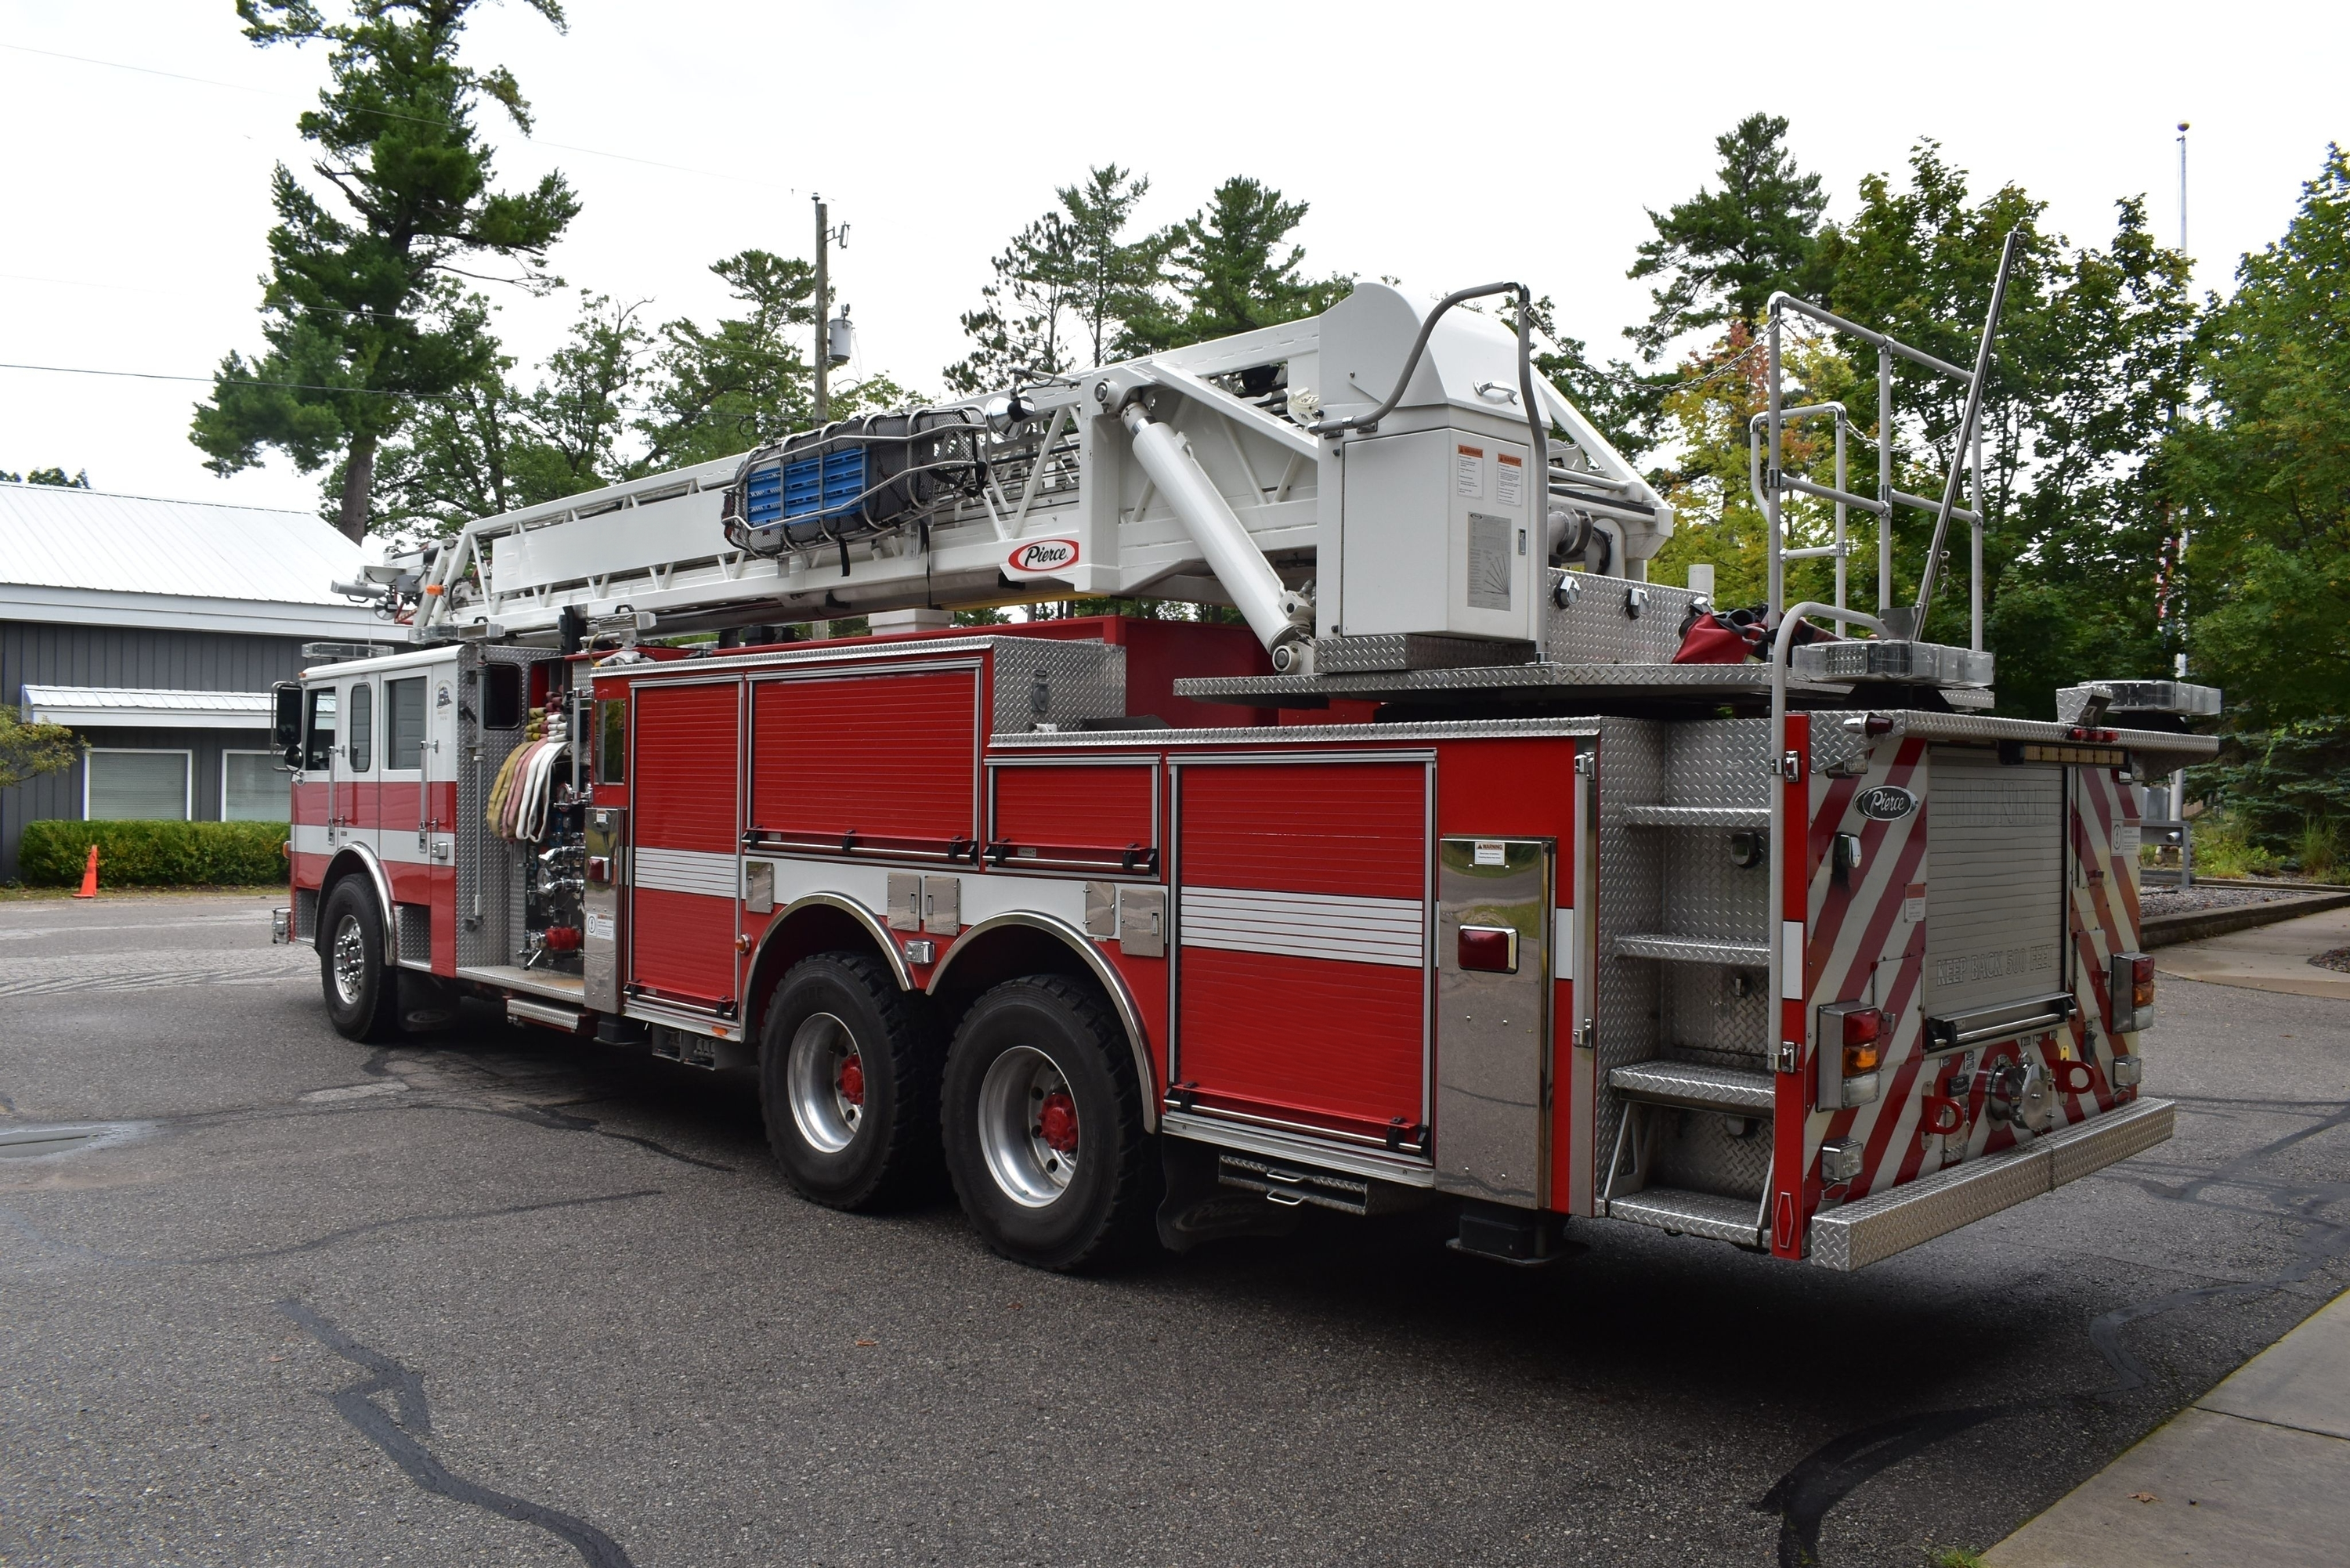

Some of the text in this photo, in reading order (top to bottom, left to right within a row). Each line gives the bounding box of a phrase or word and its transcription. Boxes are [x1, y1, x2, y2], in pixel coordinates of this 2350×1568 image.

[1025, 546, 1066, 567] Pierce
[1869, 790, 1905, 815] Pierce
[1936, 944, 2054, 986] KEEP BACK 500 FEET
